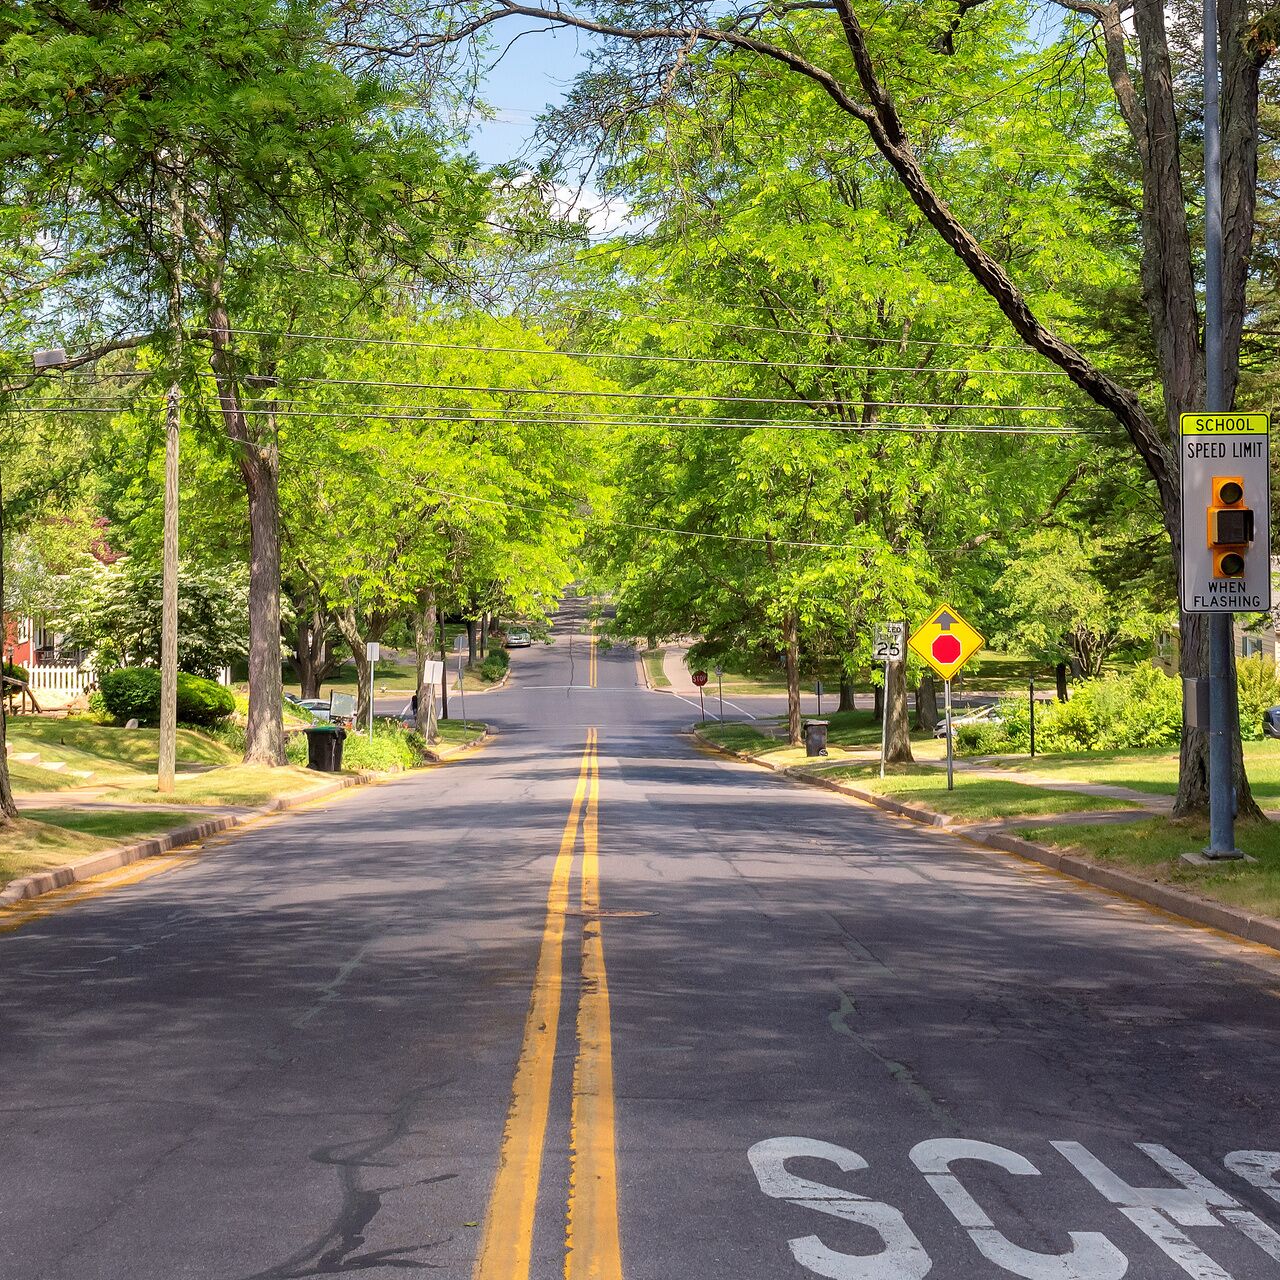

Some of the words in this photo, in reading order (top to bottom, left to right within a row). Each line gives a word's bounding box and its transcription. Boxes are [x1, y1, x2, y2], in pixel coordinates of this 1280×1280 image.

[1195, 418, 1255, 432] SCHOOL
[1187, 442, 1226, 458] SPEED
[1232, 441, 1263, 458] LIMIT
[1208, 581, 1246, 593] WHEN
[1193, 595, 1260, 607] FLASHING
[877, 642, 900, 656] 25
